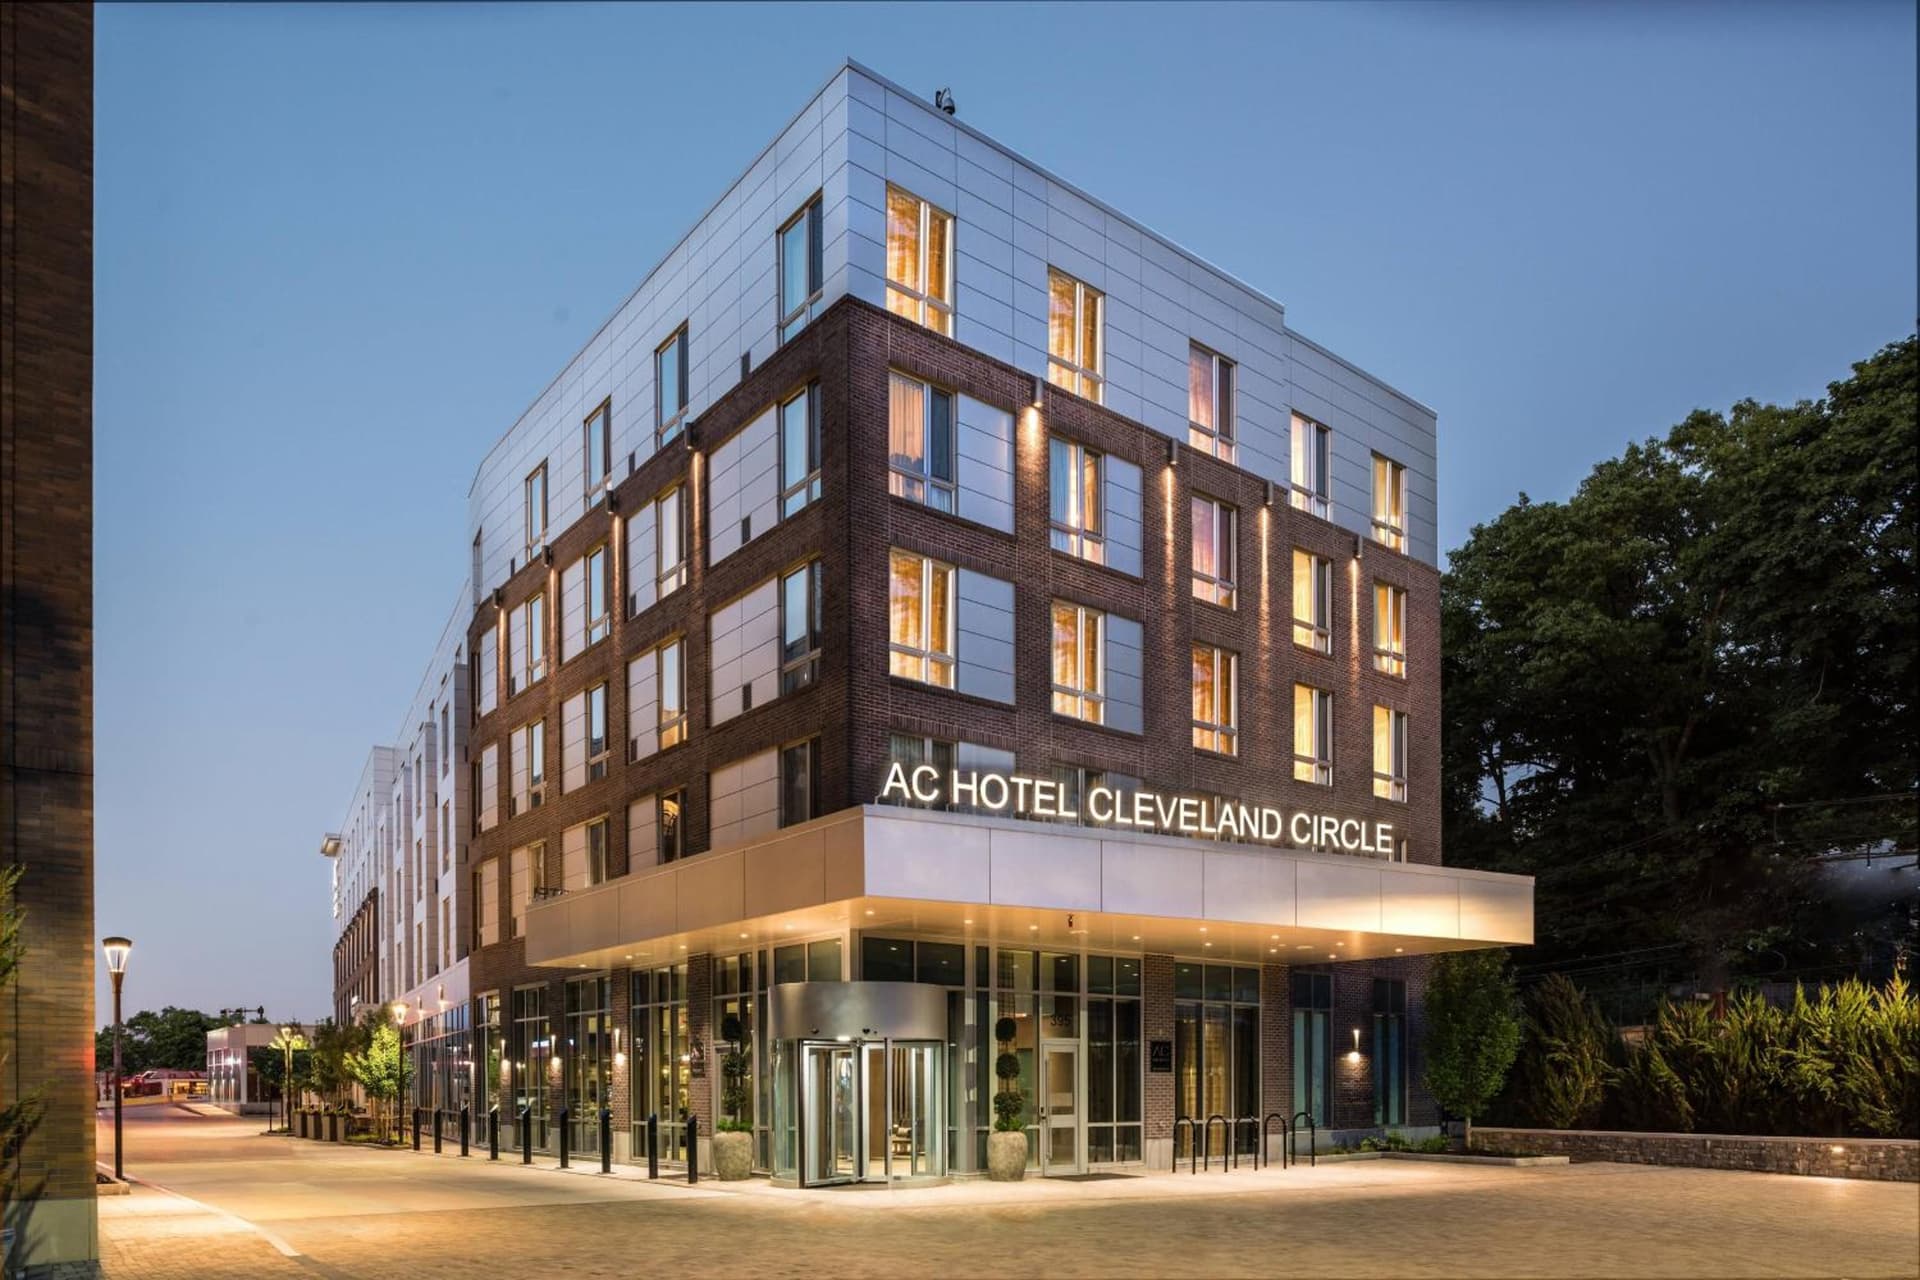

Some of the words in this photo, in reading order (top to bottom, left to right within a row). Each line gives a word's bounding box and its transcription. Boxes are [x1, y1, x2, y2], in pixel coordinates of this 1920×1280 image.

[882, 762, 940, 802] AC
[952, 769, 1078, 817] HOTEL
[1088, 787, 1282, 840] CLEVELAND
[1290, 812, 1393, 853] CIRCLE
[1050, 1014, 1072, 1027] 395
